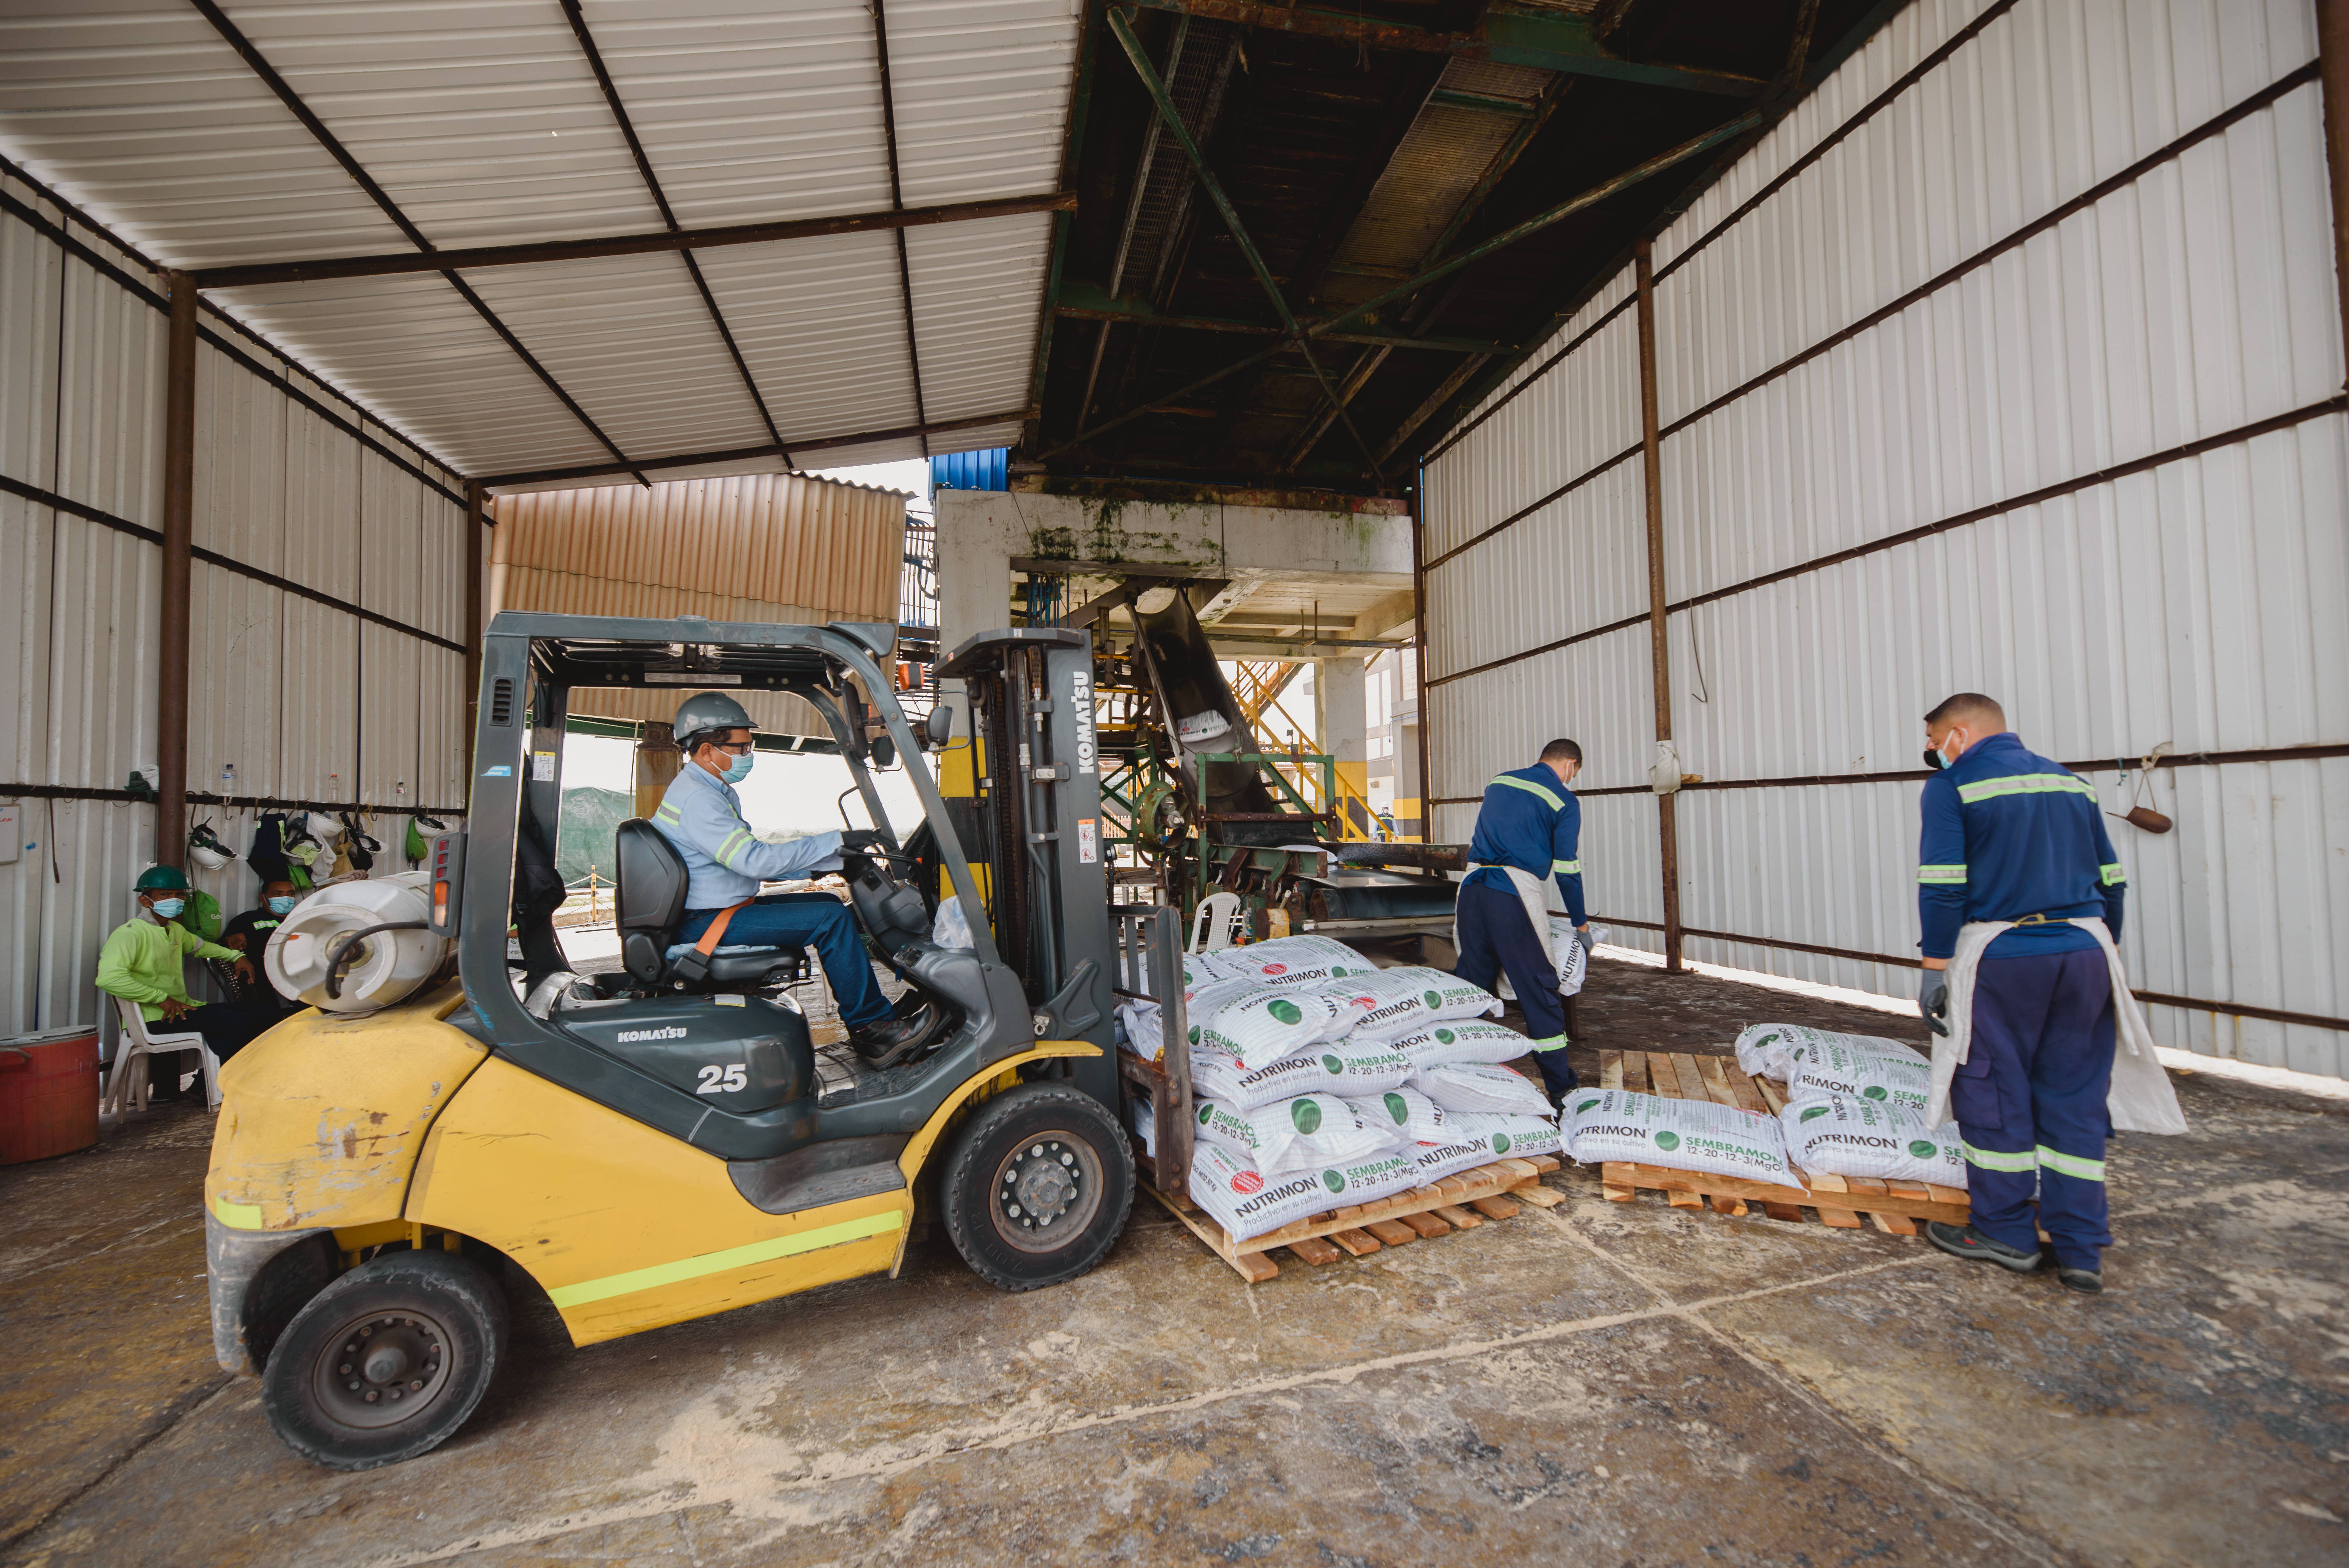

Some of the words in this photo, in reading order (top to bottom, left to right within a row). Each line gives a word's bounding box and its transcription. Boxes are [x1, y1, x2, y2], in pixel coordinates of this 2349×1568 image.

[1071, 671, 1094, 773] KOMATSU
[1265, 969, 1328, 984] NUTRIMON
[1356, 997, 1421, 1026] NUTRIMON
[618, 1026, 687, 1042] KOMATSU
[1415, 1045, 1435, 1054] cultivo
[696, 1064, 747, 1094] 25
[1238, 1057, 1318, 1088] NUTRIMON
[1246, 1080, 1281, 1096] Productivo
[1301, 1070, 1321, 1078] cultivo
[1574, 1126, 1646, 1139] UTRIMON
[1622, 1139, 1646, 1148] cultivo
[1805, 1134, 1898, 1154] NUTRIMON
[1417, 1138, 1488, 1167] NUTRIMON
[1686, 1137, 1783, 1165] SEMBRAMON
[1871, 1150, 1900, 1160] cultivo
[1235, 1177, 1318, 1218] NUTRIMON
[1243, 1206, 1280, 1228] Productivo
[1301, 1193, 1322, 1205] cultivo
